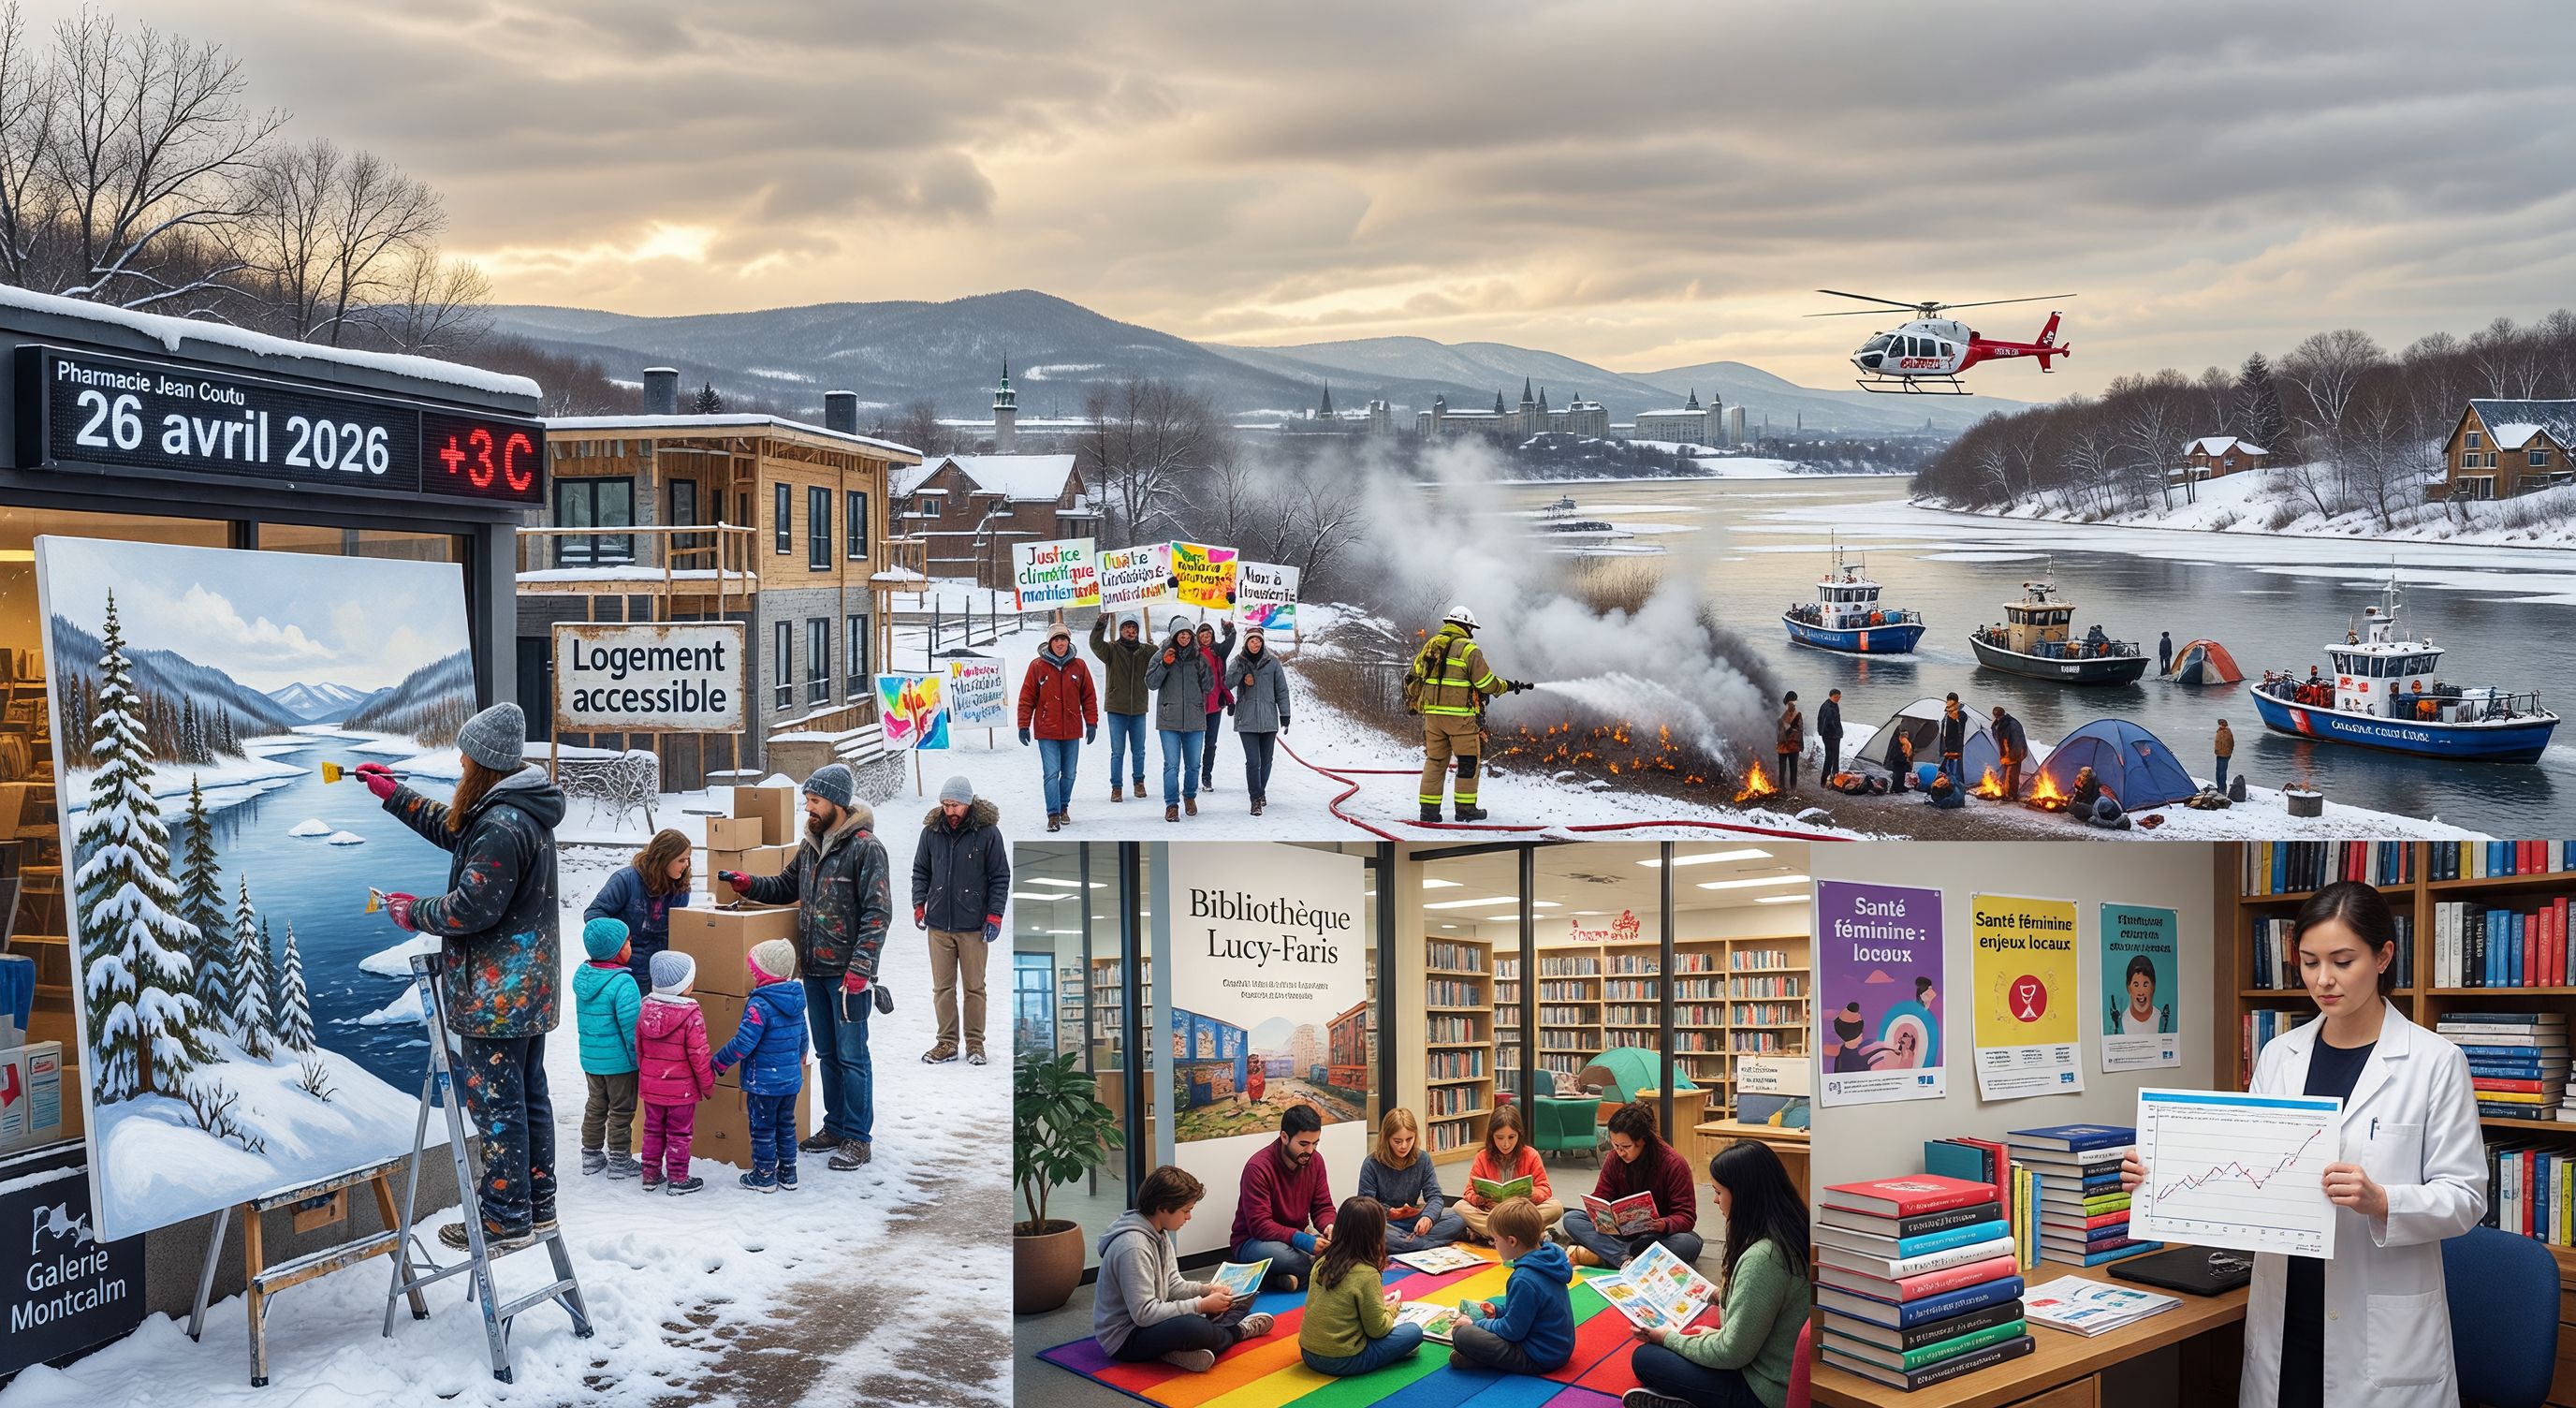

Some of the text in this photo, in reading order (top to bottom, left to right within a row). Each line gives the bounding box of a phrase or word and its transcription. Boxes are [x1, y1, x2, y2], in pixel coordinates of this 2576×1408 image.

[57, 360, 150, 393] Pharmacie
[155, 369, 195, 399] Jean
[76, 389, 389, 475] 26 avril 2026
[1026, 545, 1081, 566] Justice
[573, 639, 725, 681] Logement
[572, 678, 726, 712] accessible
[1189, 887, 1351, 935] Bibliothèque
[1854, 897, 1906, 917] Santé
[1975, 911, 2072, 931] Santé féminine
[1207, 929, 1339, 968] Lucy-Faris
[1834, 918, 1916, 941] féminine
[1980, 933, 2071, 952] enjeux locaux
[26, 1245, 109, 1293] Galerie
[10, 1275, 126, 1335] Montcalm
